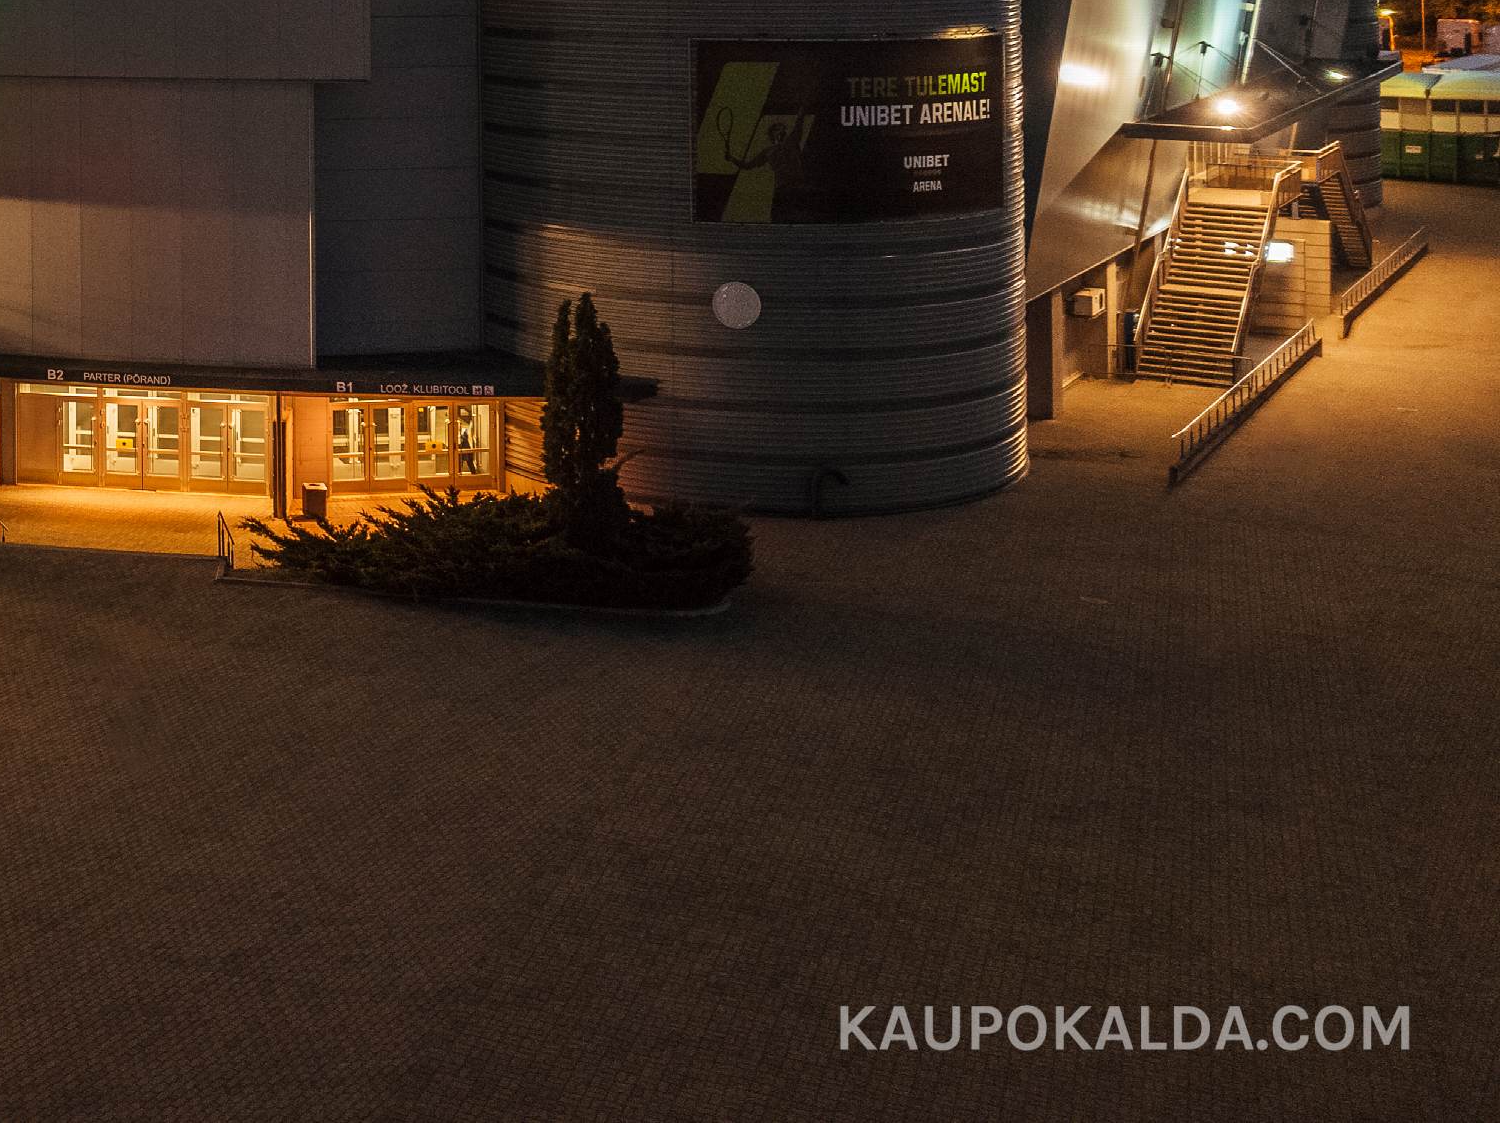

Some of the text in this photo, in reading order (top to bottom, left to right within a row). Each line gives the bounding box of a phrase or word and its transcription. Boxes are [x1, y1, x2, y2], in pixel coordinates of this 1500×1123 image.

[848, 71, 987, 98] TERE TULEMAST
[840, 98, 991, 127] UNIBET ARENALE!
[903, 154, 950, 169] UNIBET
[912, 180, 943, 193] ARENA
[47, 369, 64, 381] B2
[83, 372, 120, 382] PARTER
[336, 381, 353, 393] B1
[413, 385, 470, 395] KLUBITOOL
